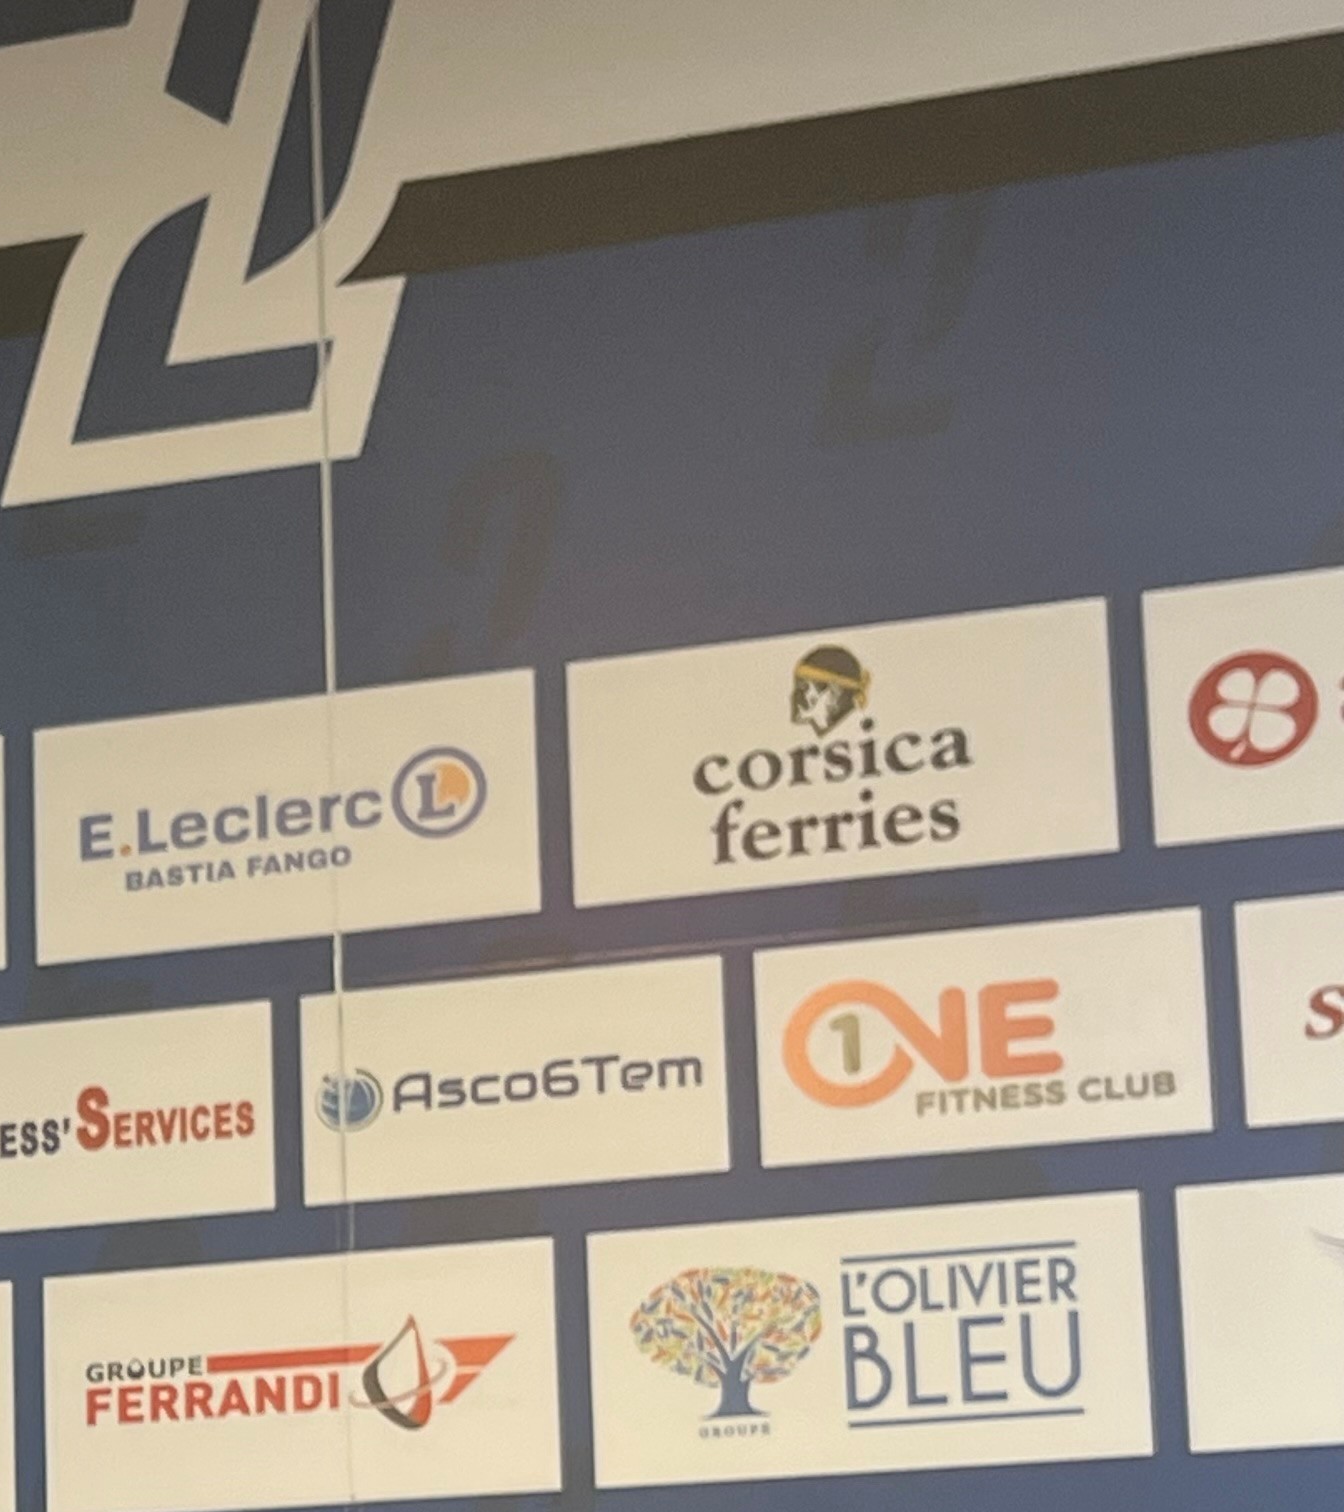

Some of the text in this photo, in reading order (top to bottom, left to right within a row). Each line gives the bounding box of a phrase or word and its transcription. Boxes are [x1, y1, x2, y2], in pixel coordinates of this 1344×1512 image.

[692, 717, 973, 797] corsica
[78, 788, 382, 861] E.Leclerc
[712, 790, 960, 865] ferries
[124, 846, 353, 892] BASTIA FANGO
[392, 1056, 703, 1113] Asco6Tem
[915, 1070, 1178, 1118] FITNESS CLUB
[841, 1257, 1076, 1318] L'OLIVIER
[86, 1355, 204, 1386] GROUPE
[842, 1311, 1081, 1411] BLEU
[86, 1373, 340, 1426] FERRANDI
